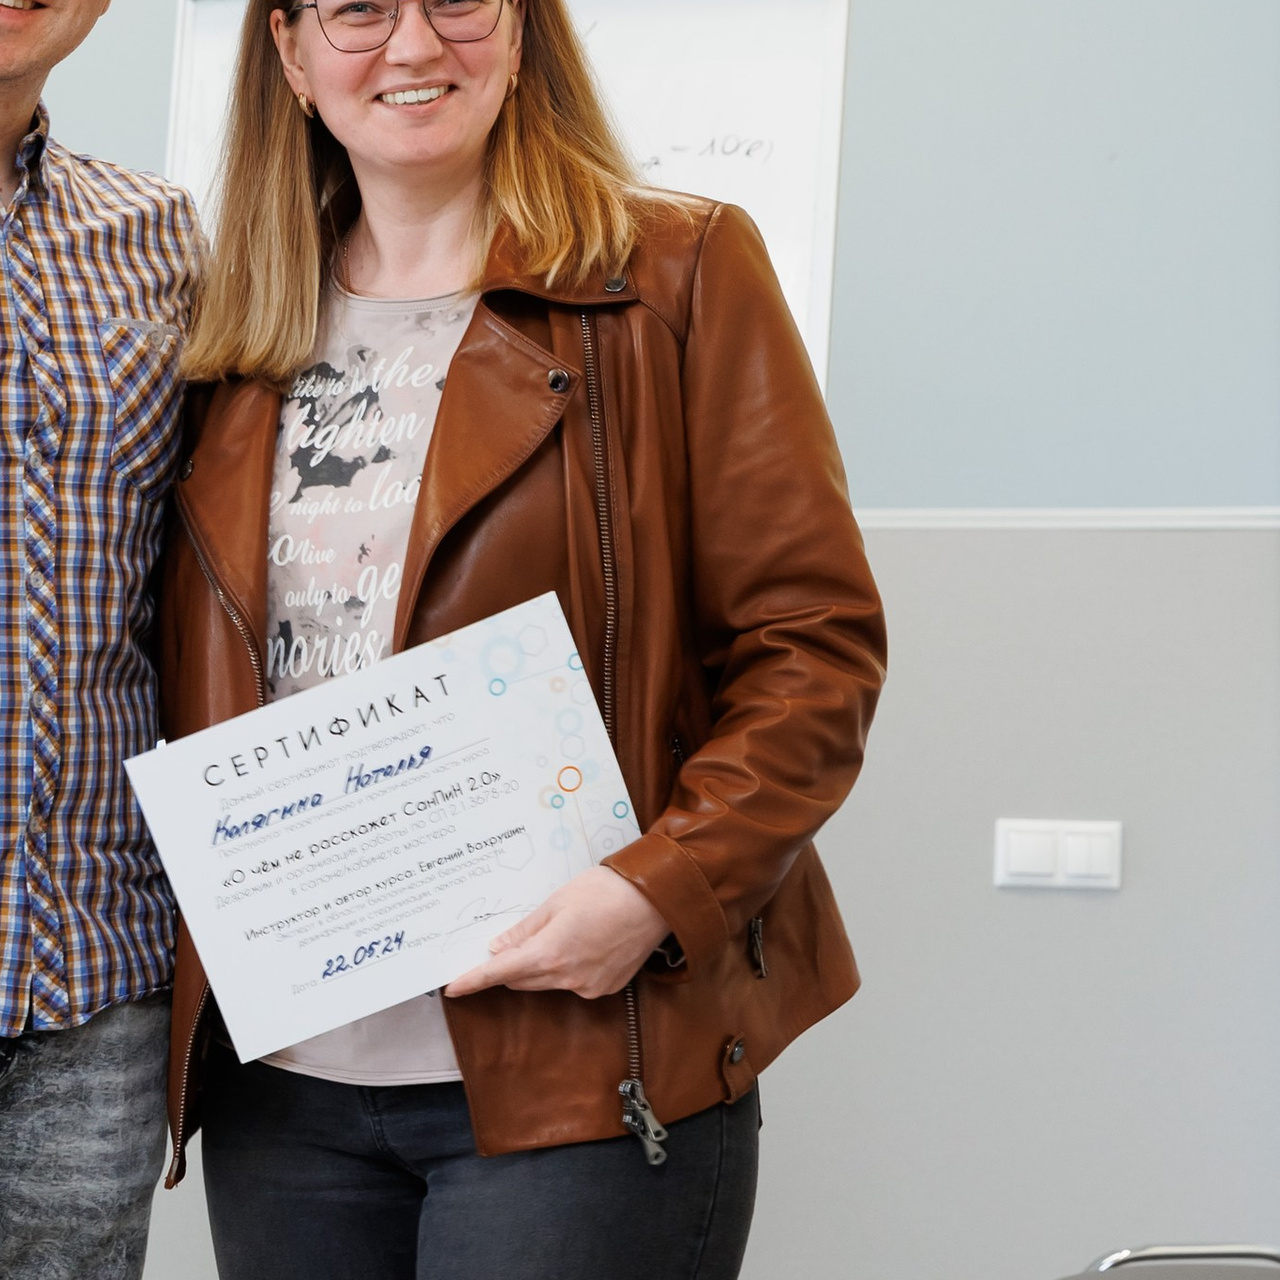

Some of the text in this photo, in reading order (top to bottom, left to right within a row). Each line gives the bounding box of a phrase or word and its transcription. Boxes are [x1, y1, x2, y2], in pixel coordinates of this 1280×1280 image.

[370, 345, 438, 394] the
[288, 491, 342, 525] night
[344, 496, 366, 514] to
[331, 582, 353, 604] to
[201, 672, 454, 789] СЕРТИФИКАТ
[216, 711, 456, 812] Данный сертификат подтверждает, что
[345, 745, 433, 795] Наталья
[431, 758, 461, 776] часть
[461, 747, 490, 765] курса
[219, 765, 502, 889] «О чём не расскажет СанПиН 2.0»
[213, 875, 274, 909] Дезрежим
[274, 875, 284, 885] и
[284, 845, 359, 882] организация
[357, 823, 409, 852] работы
[409, 817, 427, 832] по
[427, 807, 448, 824] СП
[243, 821, 527, 943] Инструктор и автор курса: Евгений Вахрушин
[289, 823, 457, 896] в салоне/кабинете мастера
[433, 874, 468, 893] лектор
[468, 863, 491, 879] НОЦ
[322, 931, 403, 978] 22.05.24
